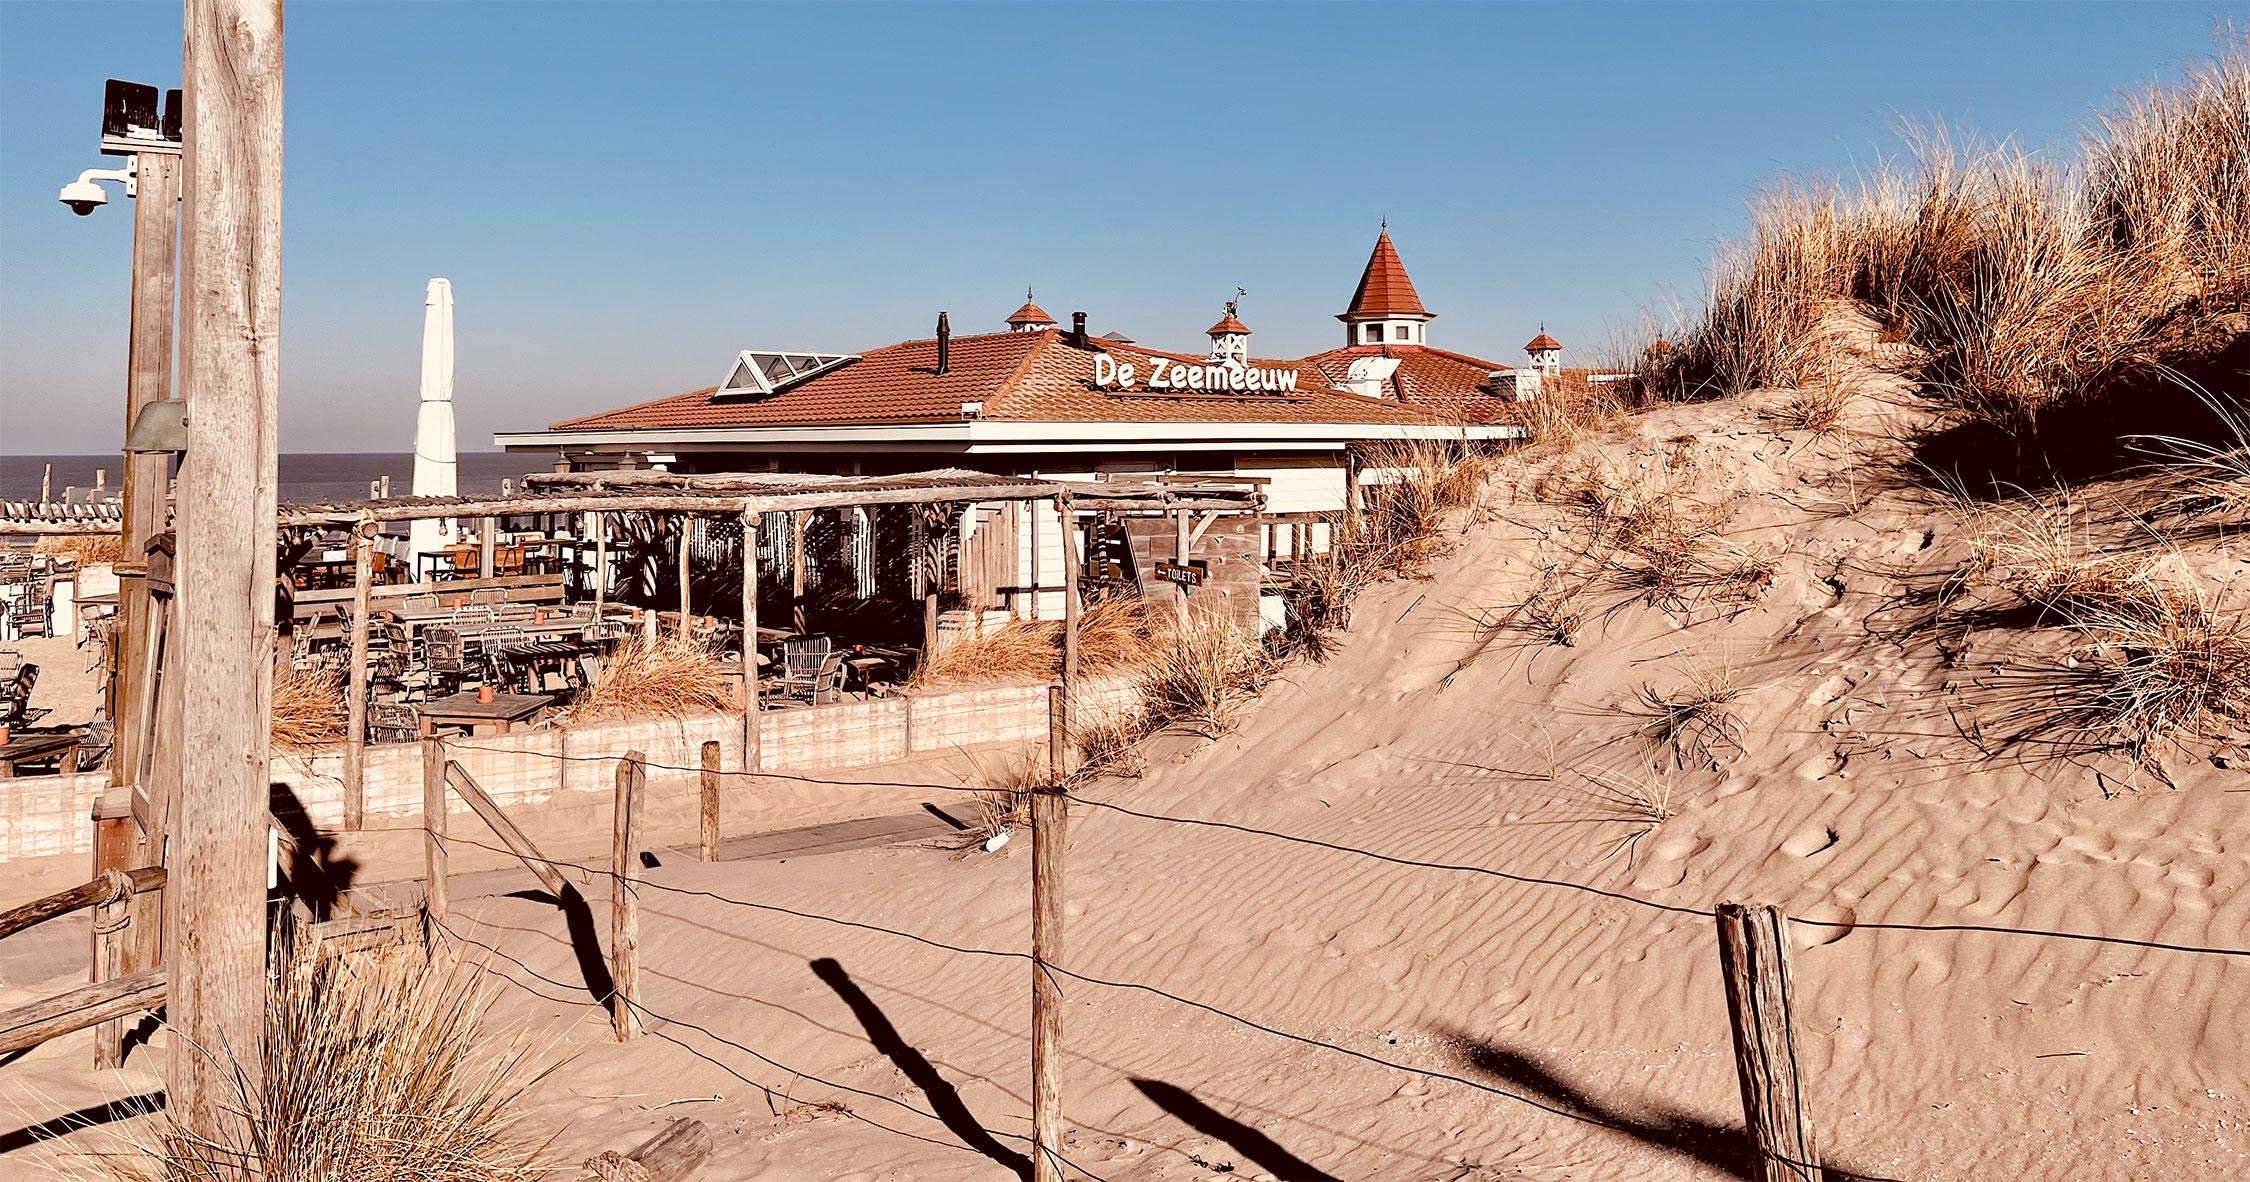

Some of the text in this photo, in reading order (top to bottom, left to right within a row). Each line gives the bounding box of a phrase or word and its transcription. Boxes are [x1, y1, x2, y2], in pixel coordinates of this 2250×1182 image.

[1093, 353, 1298, 392] De Zeemeeuw
[1167, 568, 1197, 583] TOILETS
